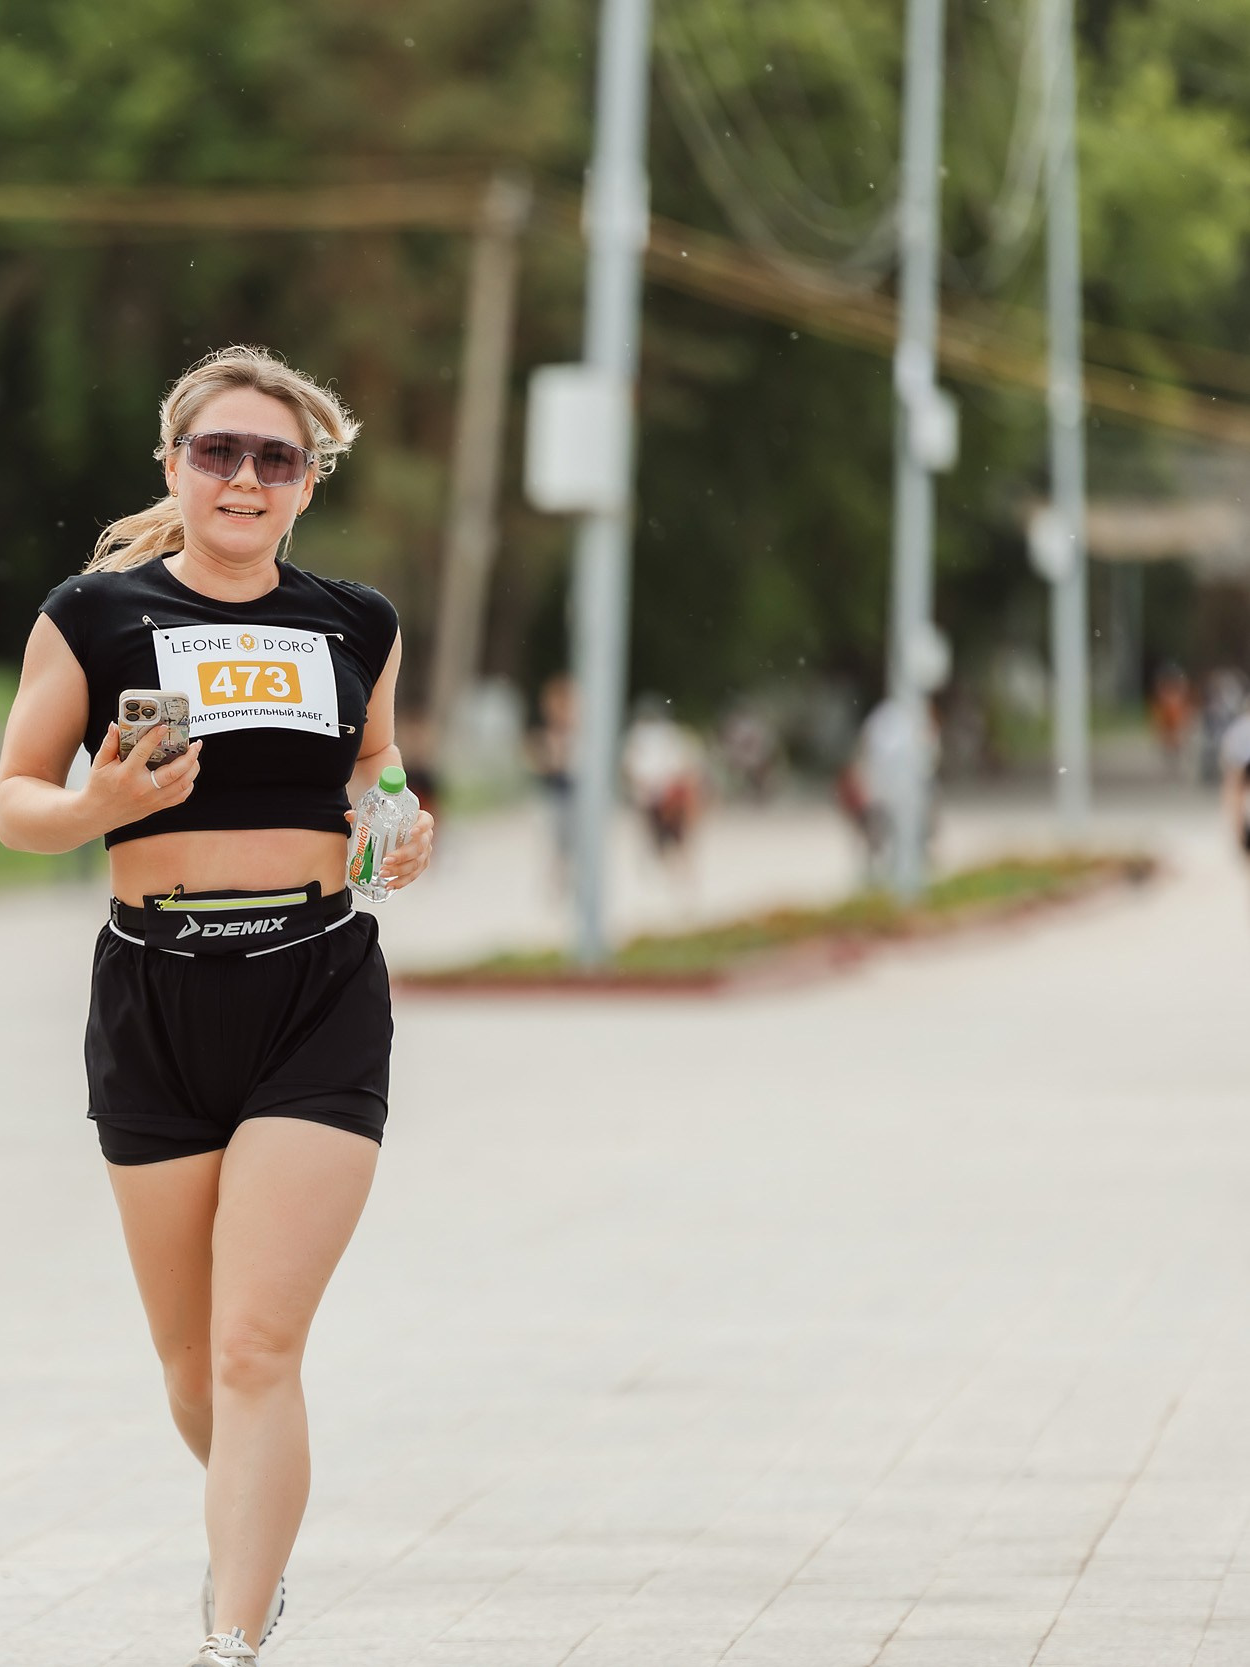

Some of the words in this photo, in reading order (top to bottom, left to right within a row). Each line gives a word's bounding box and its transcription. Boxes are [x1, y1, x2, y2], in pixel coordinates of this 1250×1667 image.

[171, 638, 232, 654] LEONE
[263, 639, 315, 654] D'ORO
[209, 666, 291, 698] 473
[191, 708, 294, 724] ЛАГОТВОРИТЕЛЬНЫЙ
[296, 710, 323, 721] ЗАБЕГ
[349, 826, 369, 884] #Grenwich
[201, 916, 288, 937] DEMIX
